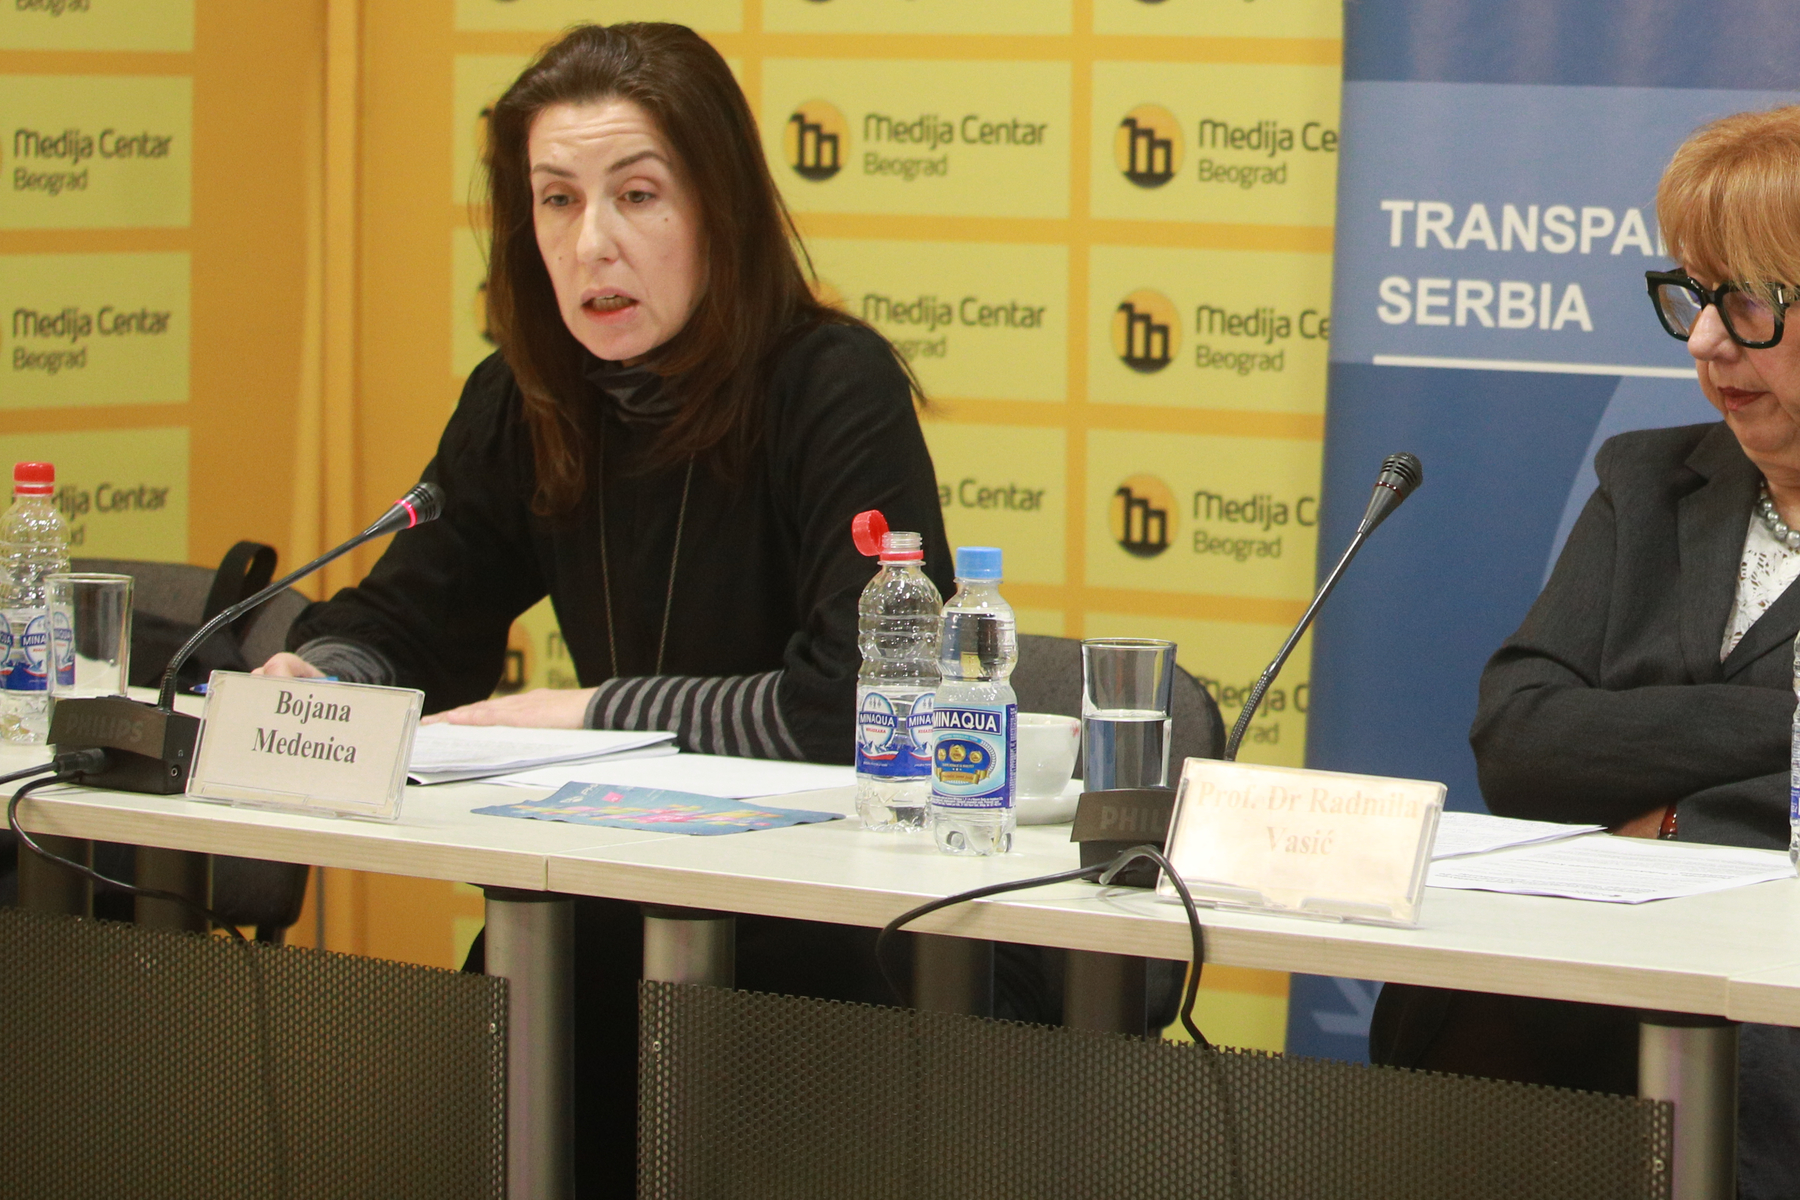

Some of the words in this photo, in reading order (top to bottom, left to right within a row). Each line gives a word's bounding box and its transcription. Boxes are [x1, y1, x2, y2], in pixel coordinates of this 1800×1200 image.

[98, 128, 172, 159] Centar
[960, 114, 1047, 146] Centar
[13, 167, 88, 195] Beograd
[864, 154, 949, 182] Beograd
[1198, 159, 1288, 189] Beograd
[1380, 200, 1669, 257] TRANSPA
[959, 296, 1045, 329] Centar
[1376, 275, 1594, 333] SERBIA
[96, 305, 171, 336] Centar
[12, 347, 87, 374] Beograd
[1196, 345, 1285, 376] Beograd
[958, 478, 1044, 511] Centar
[1193, 530, 1282, 561] Beograd
[274, 689, 352, 725] Bojana
[251, 727, 358, 764] Medenica
[1195, 780, 1257, 810] Prof.
[1266, 784, 1303, 812] Dr
[1306, 786, 1420, 819] Radmila
[1100, 805, 1165, 833] PHIL
[1265, 825, 1335, 856] Vasić
